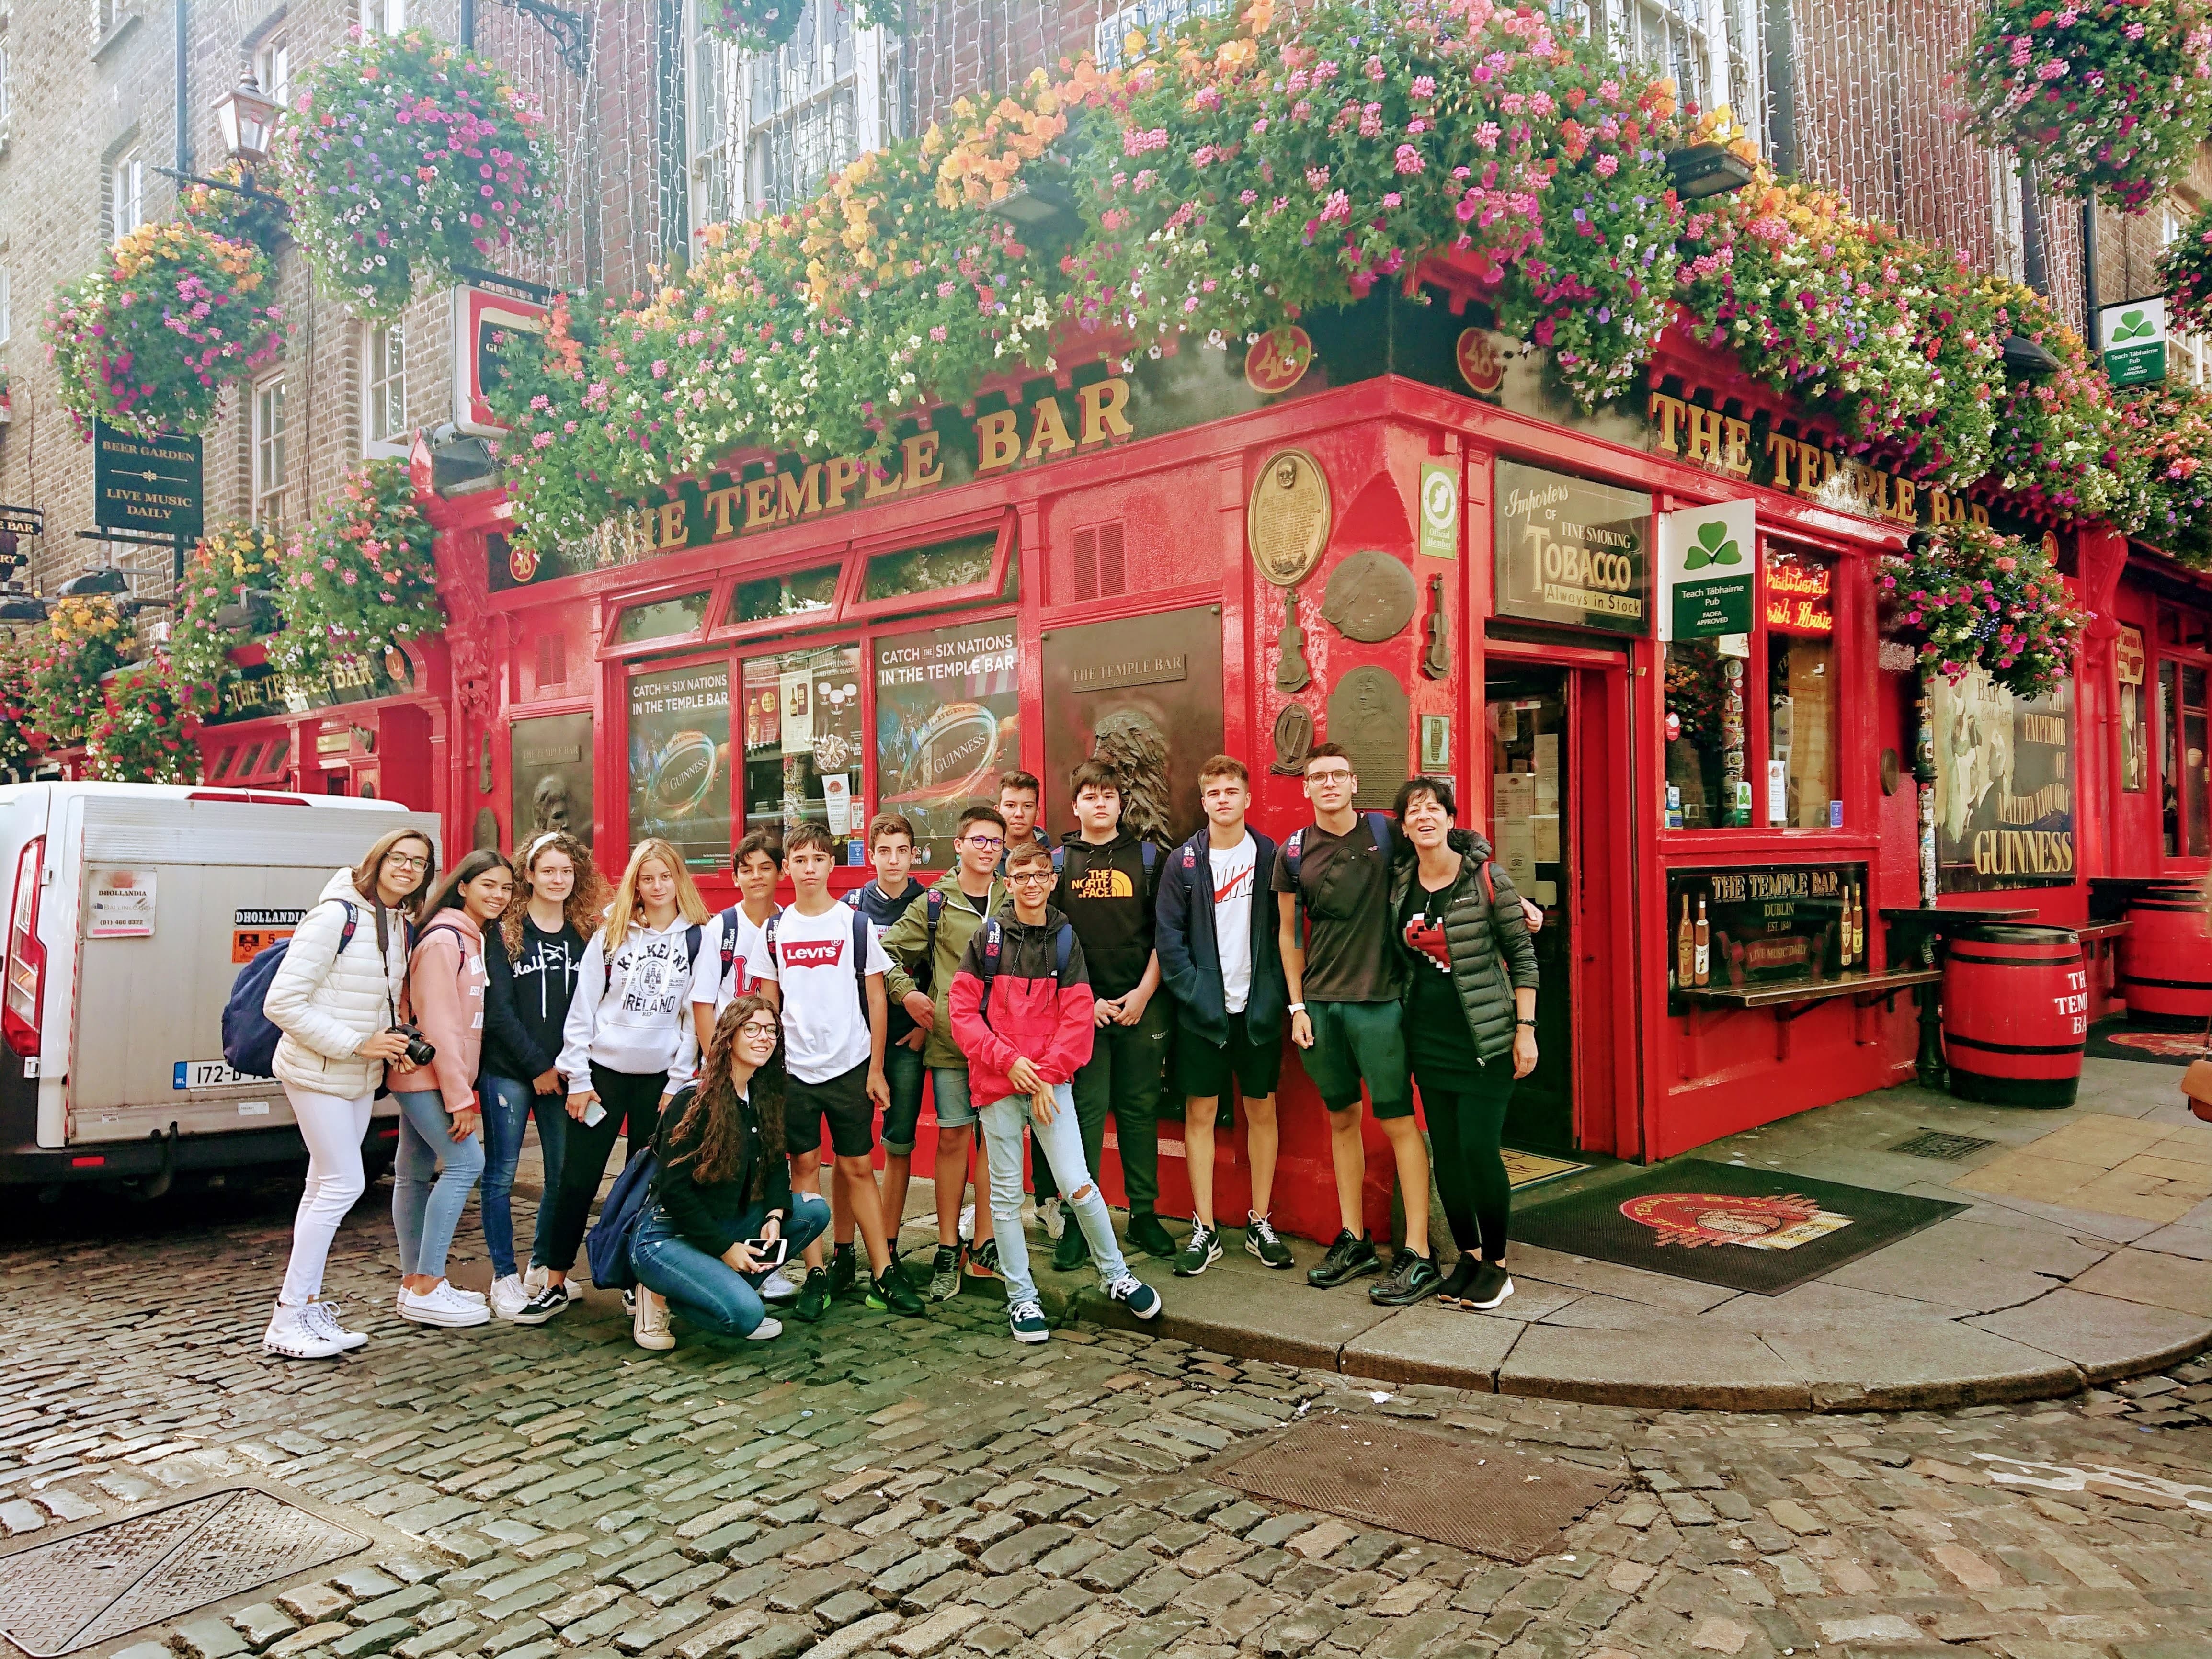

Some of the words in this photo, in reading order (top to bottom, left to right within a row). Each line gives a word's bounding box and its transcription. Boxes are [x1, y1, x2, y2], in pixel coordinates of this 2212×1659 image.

[2123, 369, 2147, 377] APPROVED
[1652, 391, 1752, 475] THE
[103, 441, 137, 454] BEER
[140, 446, 194, 462] GARDEN
[706, 430, 944, 535] TEMPLE
[976, 377, 1134, 471] BAR
[107, 488, 141, 501] LIVE
[145, 493, 192, 507] MUSIC
[1504, 484, 1568, 523] Importers
[126, 505, 172, 519] DAILY
[1545, 509, 1556, 521] OF
[7, 521, 34, 533] BAR
[1429, 528, 1450, 539] Official
[1562, 522, 1585, 540] FINE
[1586, 527, 1631, 549] SMOKING
[1427, 536, 1451, 549] Member
[1522, 523, 1631, 593] TOBACCO
[1547, 585, 1587, 606] Always
[1594, 594, 1604, 609] in
[1609, 595, 1639, 614] Stock
[1682, 589, 1704, 598] Teach
[1705, 585, 1744, 595] Tábhairne
[1705, 597, 1720, 606] Pub
[1697, 617, 1728, 625] APPROVED
[1767, 598, 1790, 624] rish
[882, 648, 920, 665] CATCH
[936, 642, 955, 658] SIX
[957, 634, 1013, 655] NATIONS
[333, 655, 375, 690] BAR
[831, 659, 854, 668] GUINNESS
[881, 670, 894, 685] IN
[898, 667, 924, 683] THE
[927, 659, 980, 680] TEMPLE
[984, 655, 1014, 672] BAR
[1072, 668, 1096, 682] THE
[1099, 660, 1151, 679] TEMPLE
[1155, 656, 1182, 671] BAR
[633, 683, 661, 698] CATCH
[672, 680, 685, 693] SIX
[687, 674, 727, 691] NATIONS
[1977, 678, 2002, 706] BAR
[632, 702, 642, 715] IN
[645, 700, 663, 714] THE
[665, 694, 704, 711] TEMPLE
[707, 692, 728, 706] BAR
[2024, 713, 2065, 746] EMPEROR
[934, 733, 986, 773] GUINNESS
[670, 757, 707, 790] GUINNESS
[2056, 752, 2066, 779] OF
[2035, 783, 2070, 820] LIQUORS
[1974, 829, 2072, 875] GUINNESS
[1072, 878, 1110, 890] NORTH
[1088, 870, 1109, 879] THE
[1712, 875, 1745, 902] THE
[1749, 873, 1808, 899] TEMPLE
[1812, 871, 1839, 896] BAR
[235, 911, 306, 923] DHOLLANDIA
[1764, 902, 1794, 917] DUBLIN
[1767, 922, 1779, 932] EST.
[1749, 950, 1764, 962] LIVE
[1767, 947, 1786, 958] MUSIC
[1789, 944, 1808, 956] DAILY
[2068, 970, 2087, 990] TH
[623, 992, 676, 1012] IRELAND
[2054, 992, 2088, 1015] TEM
[2073, 1015, 2087, 1034] BA
